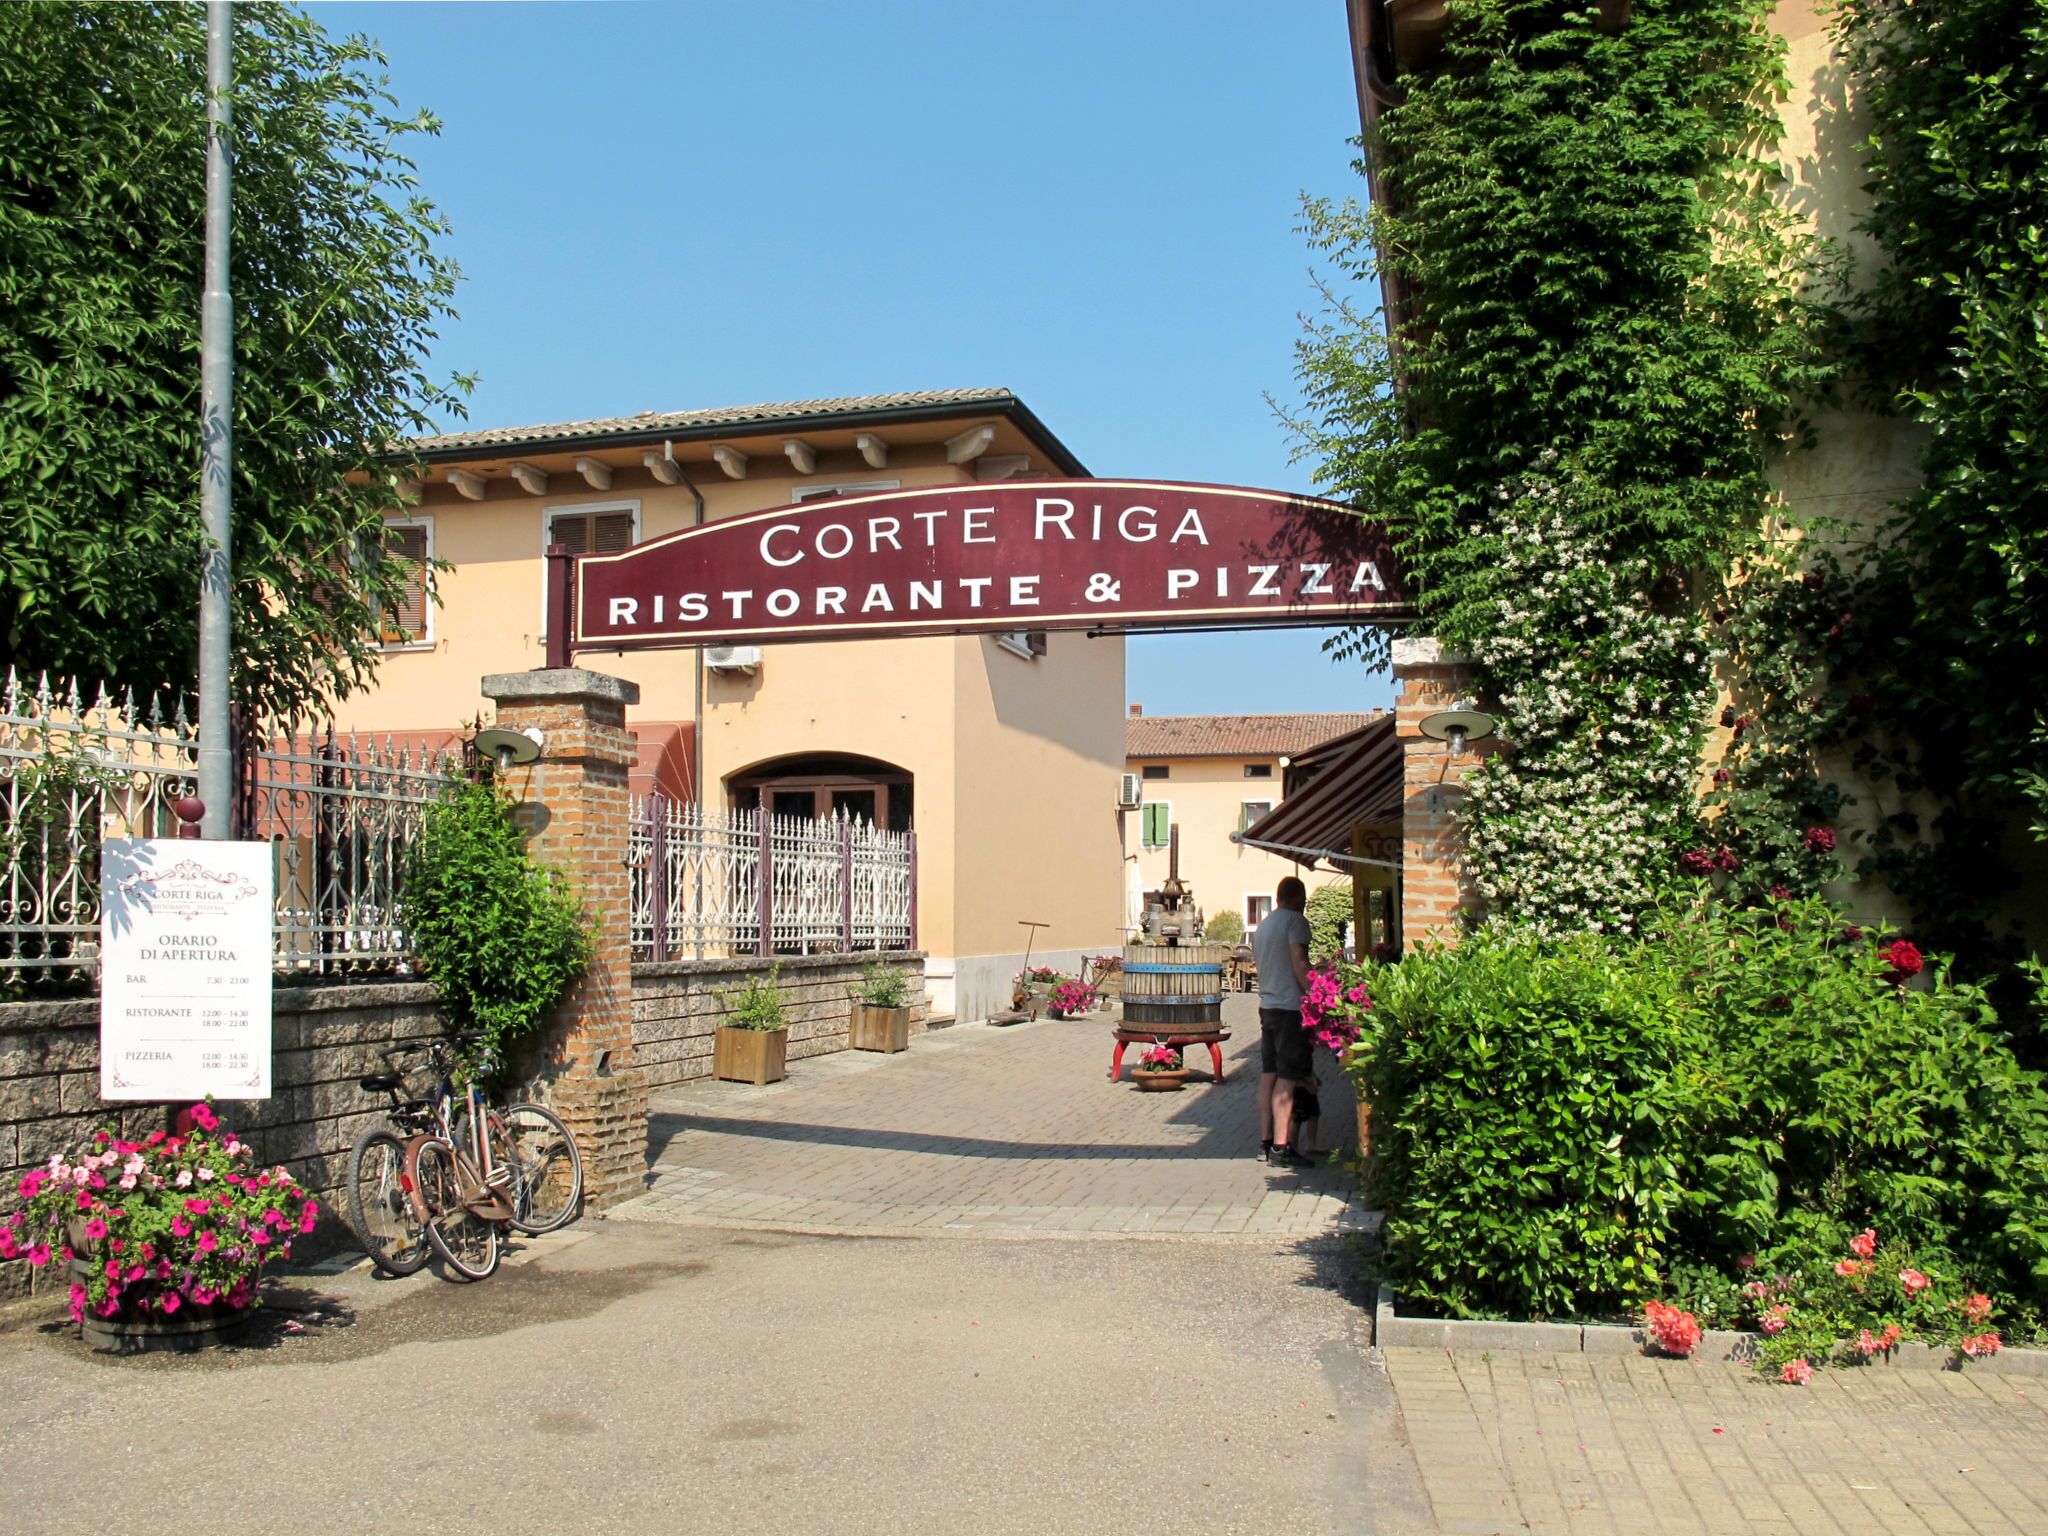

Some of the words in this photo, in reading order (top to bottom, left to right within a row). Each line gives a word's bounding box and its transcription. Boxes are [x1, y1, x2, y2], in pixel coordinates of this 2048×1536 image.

[758, 506, 996, 567] CORTE
[1034, 498, 1209, 545] RIGA
[608, 574, 1041, 626] RISTORANTE
[1085, 572, 1121, 602] &
[1166, 561, 1386, 599] PIZZA
[154, 890, 190, 900] CORTE
[195, 890, 223, 901] RIGA
[158, 935, 217, 947] ORARIO
[140, 948, 158, 961] DI
[161, 949, 237, 962] APERTURA
[126, 974, 147, 984] BAR
[125, 1008, 193, 1018] RISTORANTE
[125, 1051, 174, 1061] PIZZERIA
